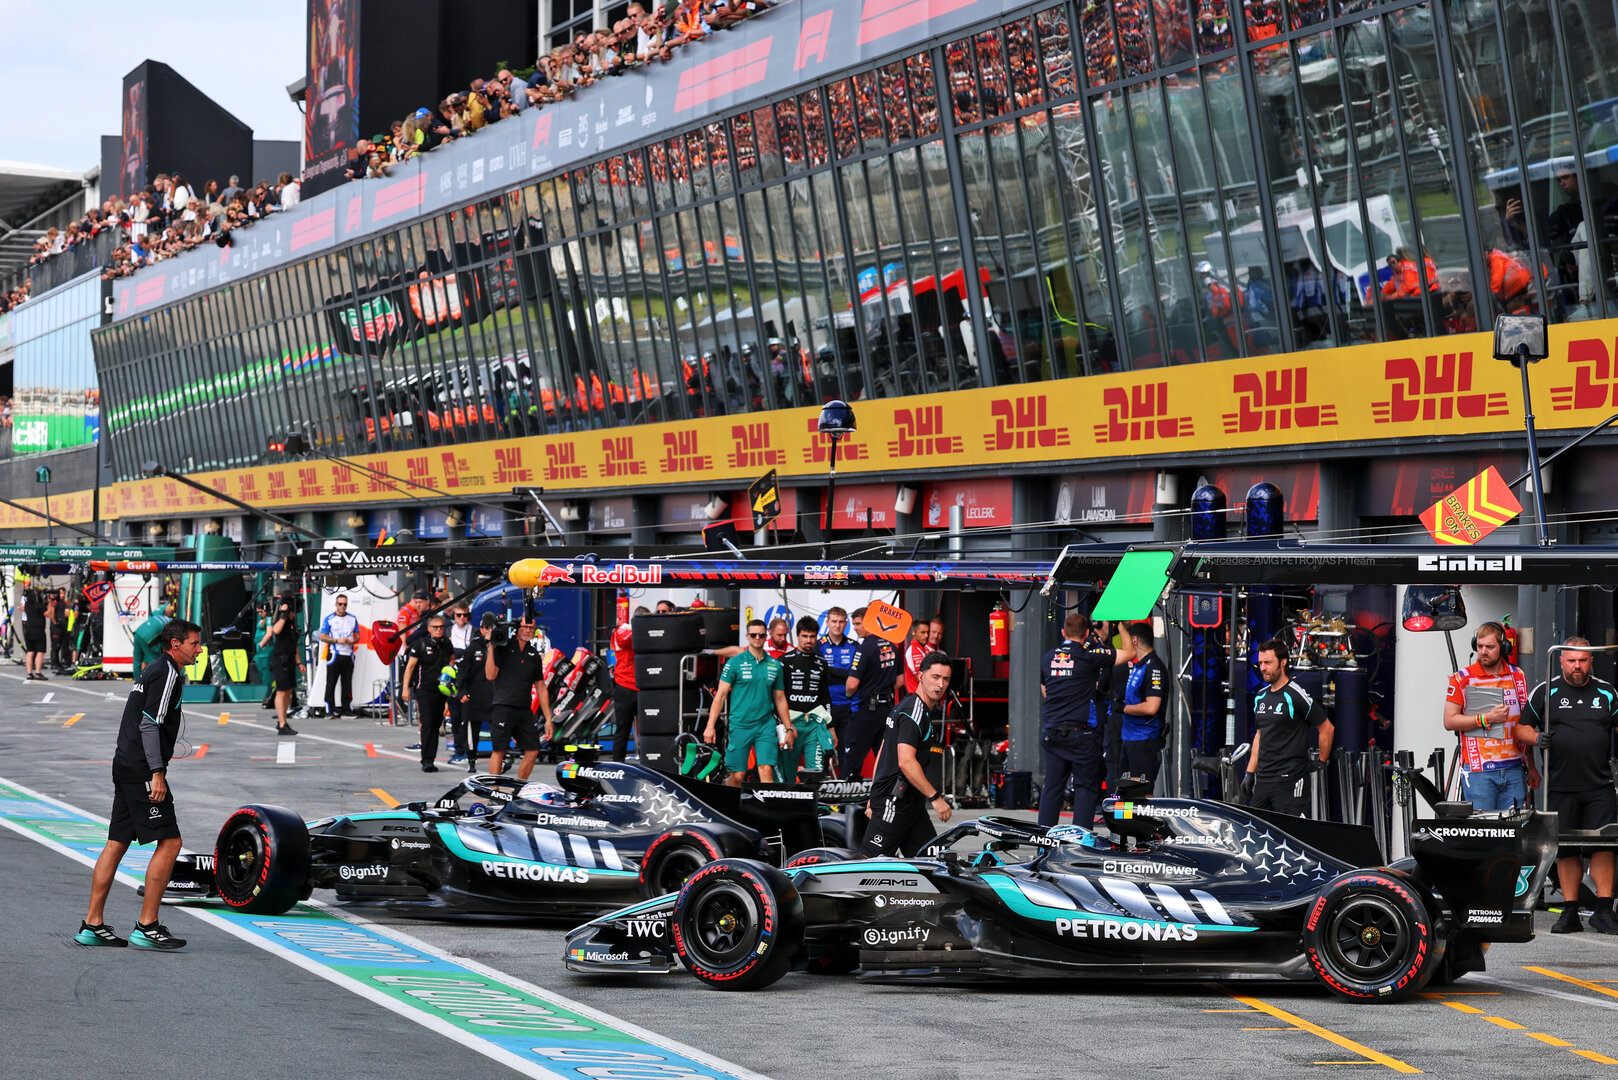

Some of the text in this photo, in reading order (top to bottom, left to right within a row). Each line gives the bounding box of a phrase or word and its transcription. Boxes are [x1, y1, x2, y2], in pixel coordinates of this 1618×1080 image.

[1385, 352, 1486, 422] DHL
[1234, 367, 1320, 433] DHL
[1104, 382, 1178, 442] DHL
[894, 405, 952, 456] DHL
[991, 395, 1056, 450] DHL
[663, 430, 704, 472] DHL
[732, 422, 777, 467] DHL
[546, 442, 581, 480] DHL
[602, 436, 640, 476] DHL
[407, 456, 433, 490] DHL
[495, 447, 528, 483] DHL
[856, 511, 886, 522] HAMTON
[966, 507, 996, 519] LECLERC
[1082, 509, 1116, 520] LAWSON
[1445, 494, 1481, 540] BRAKES
[1445, 516, 1461, 535] ON
[60, 549, 92, 557] aramco
[316, 551, 426, 564] CEVA LOGISTICS
[1280, 556, 1337, 566] PETRONAS
[1338, 556, 1348, 566] F1
[1348, 556, 1376, 566] Team
[127, 562, 151, 570] Gulf
[1418, 555, 1523, 571] Einhell
[582, 564, 662, 584] Red Bull
[880, 604, 902, 620] BRAKES
[577, 766, 625, 780] Microsoft
[490, 791, 507, 800] AMD
[757, 790, 814, 800] CROWDSTRIKE
[818, 781, 873, 799] CROWDST
[603, 794, 638, 803] SOLERA
[1136, 804, 1200, 818] Microsoft
[548, 814, 609, 828] TeamViewer
[1029, 835, 1051, 845] AMD
[1175, 835, 1224, 845] SOLERA
[1435, 827, 1516, 838] CROWDSTRIKE
[401, 840, 431, 849] Snapdragon
[788, 856, 819, 868] ERO
[1118, 861, 1199, 875] TeamViewer
[340, 864, 389, 880] signify
[482, 860, 590, 884] PETRONAS
[878, 879, 918, 887] AMG
[753, 882, 773, 932] ZERO
[889, 897, 935, 907] Snapdragon
[1307, 896, 1327, 931] PIRELLI
[1467, 916, 1503, 924] PRIMAX
[626, 920, 665, 938] IWC
[864, 927, 930, 945] signify
[1055, 918, 1198, 942] PETRONAS
[586, 951, 629, 961] Microsoft
[1397, 938, 1427, 989] ZERO
